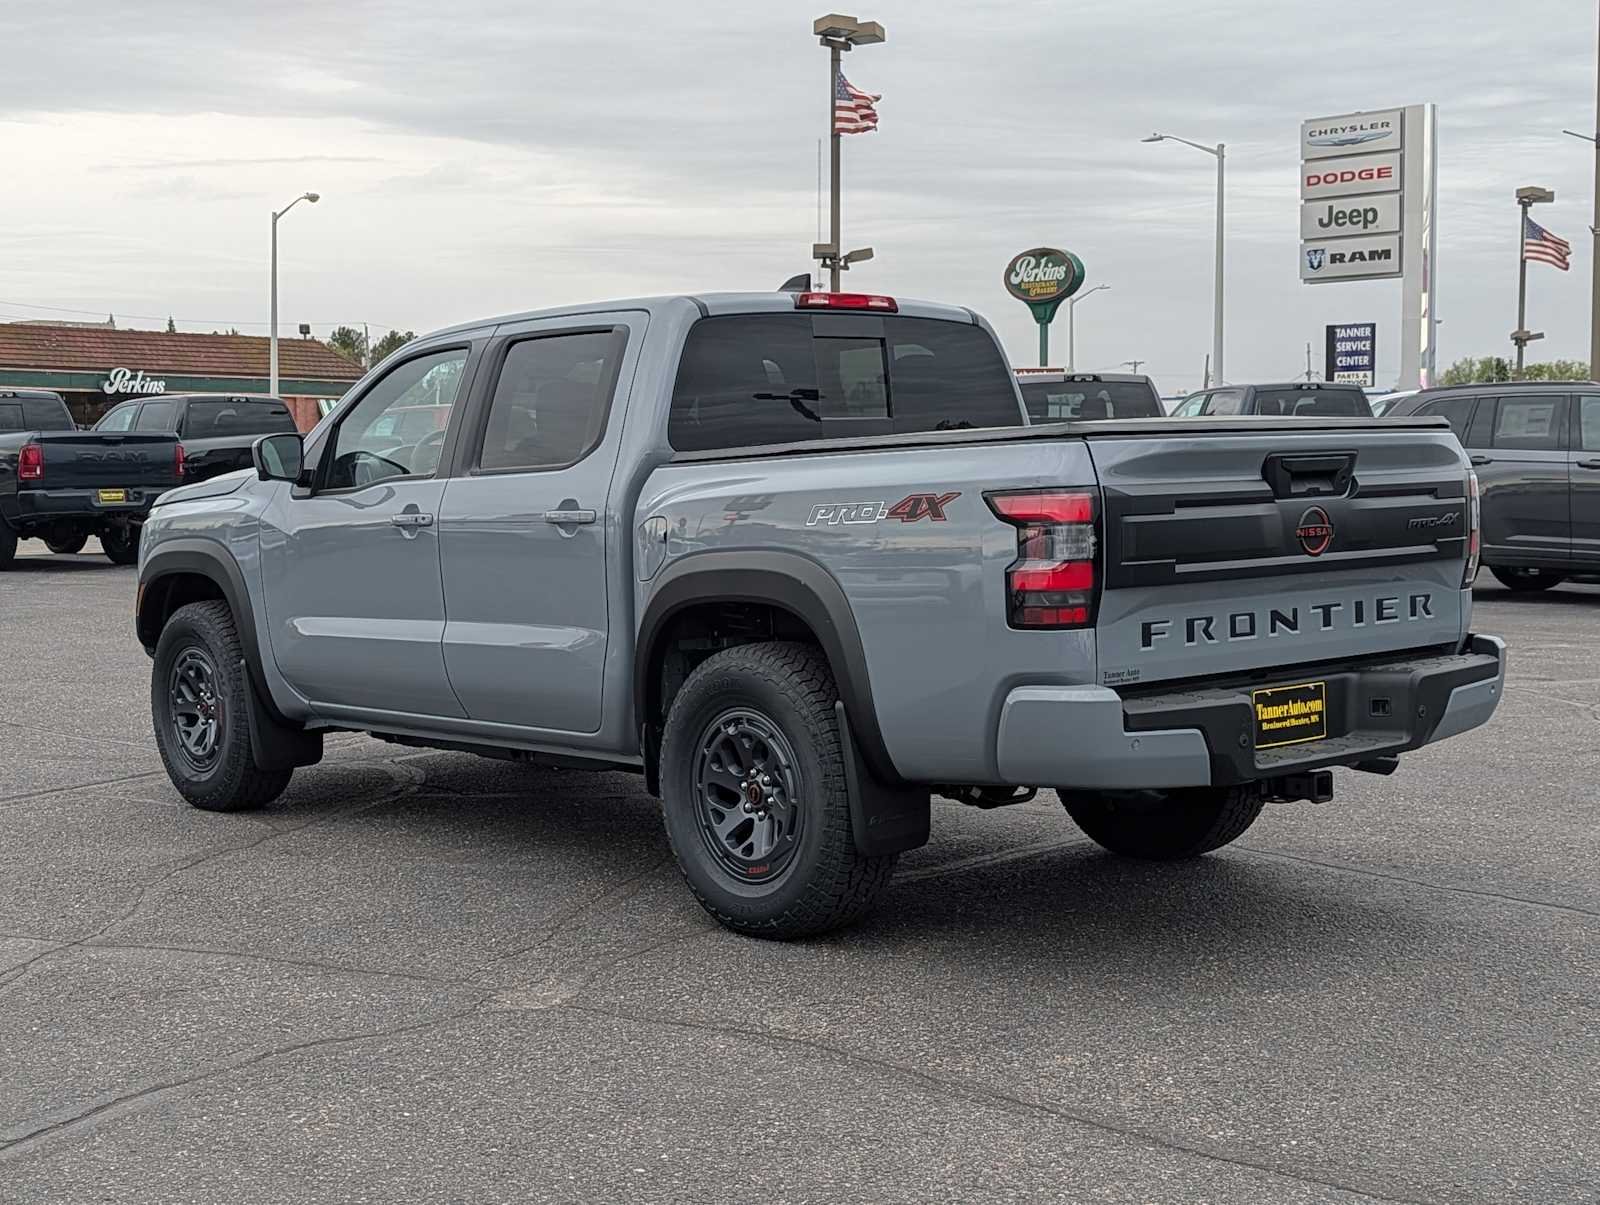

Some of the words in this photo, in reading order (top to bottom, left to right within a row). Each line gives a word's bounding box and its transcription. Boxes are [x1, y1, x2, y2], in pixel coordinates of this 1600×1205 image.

[1308, 121, 1391, 138] CHRYSLER
[1306, 166, 1393, 187] DODGE
[1317, 205, 1378, 230] Jeep
[1329, 248, 1392, 265] RAM
[1009, 256, 1067, 285] Perkins
[1335, 327, 1371, 338] TANNER
[1336, 341, 1371, 352] SERVICE
[1336, 356, 1369, 367] CENTER
[103, 367, 166, 395] Perkins
[805, 492, 962, 527] PRO-4X
[1296, 526, 1333, 538] NISSAN
[1140, 593, 1434, 649] FRONTIER
[1256, 699, 1323, 721] TannerAuto.com
